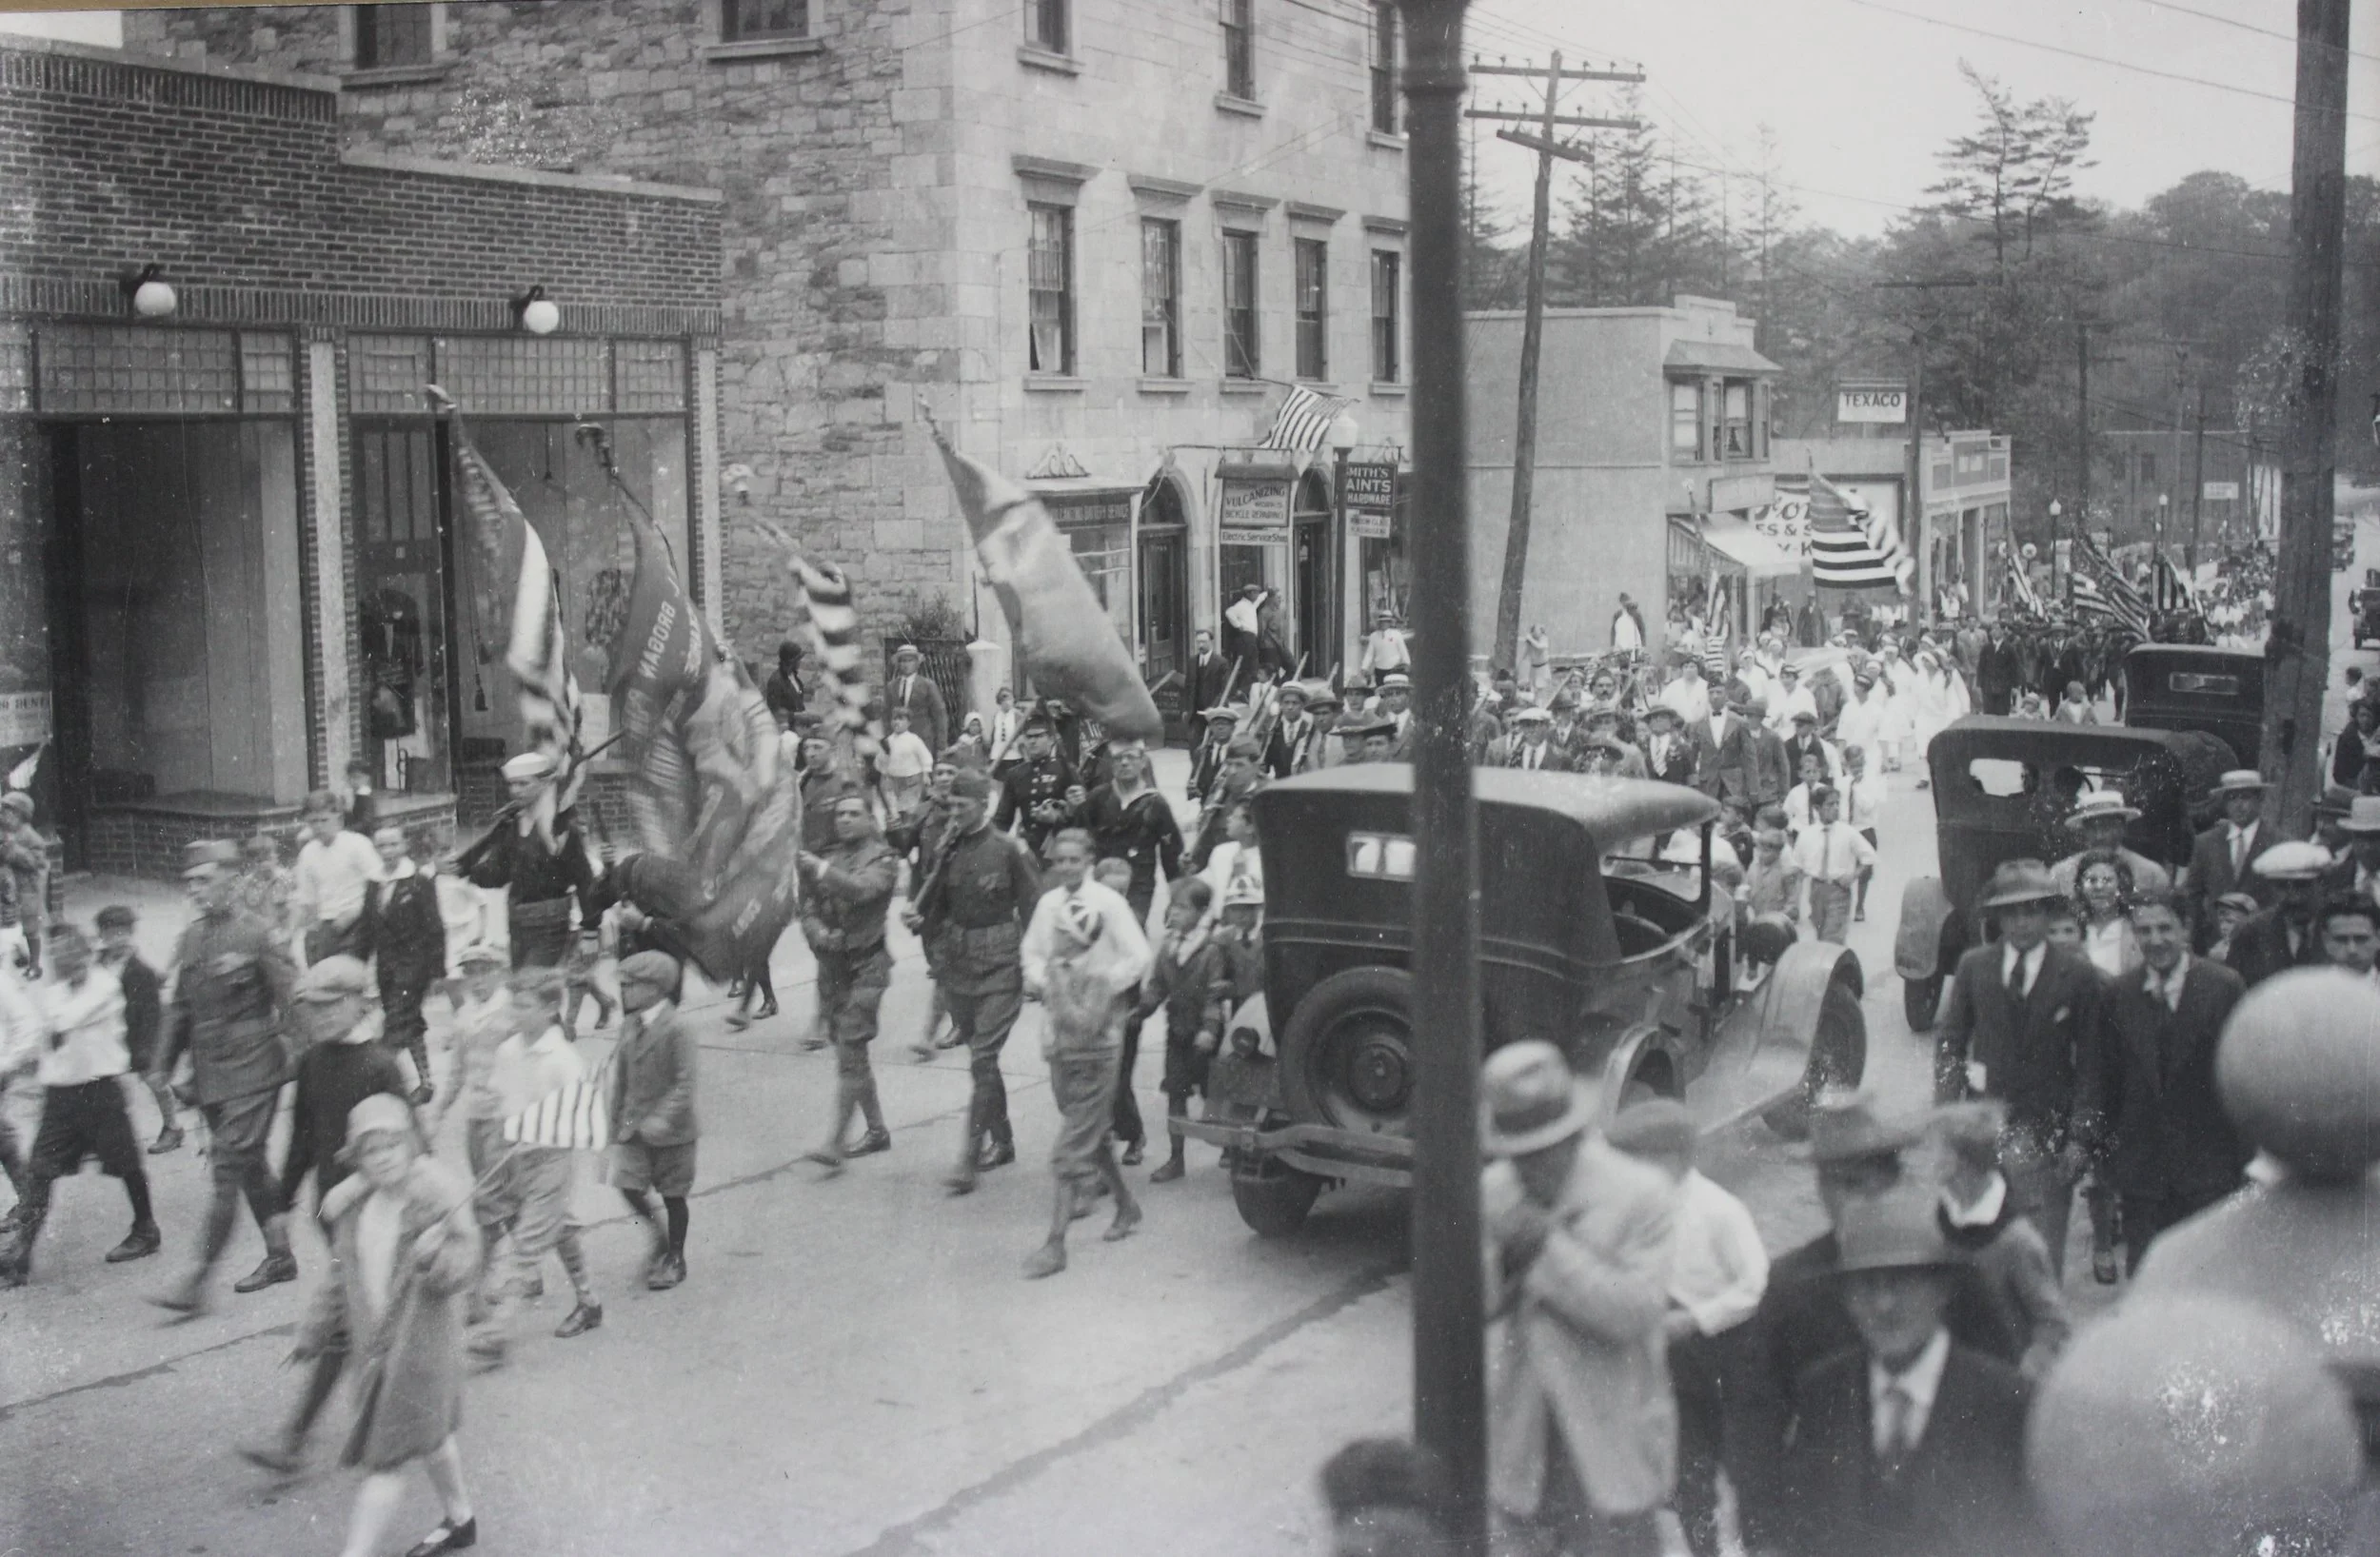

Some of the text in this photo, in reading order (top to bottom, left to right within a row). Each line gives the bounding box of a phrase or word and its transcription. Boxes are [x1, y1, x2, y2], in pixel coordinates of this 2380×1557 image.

[1844, 392, 1901, 407] TEXACO
[1345, 479, 1392, 493] AINTS
[1225, 486, 1285, 507] VULCANIZING
[1347, 493, 1391, 505] HARDWARE
[1225, 509, 1250, 519] BICYCLE
[1784, 523, 1797, 536] &
[1222, 531, 1247, 542] Electric
[1247, 531, 1271, 542] Service
